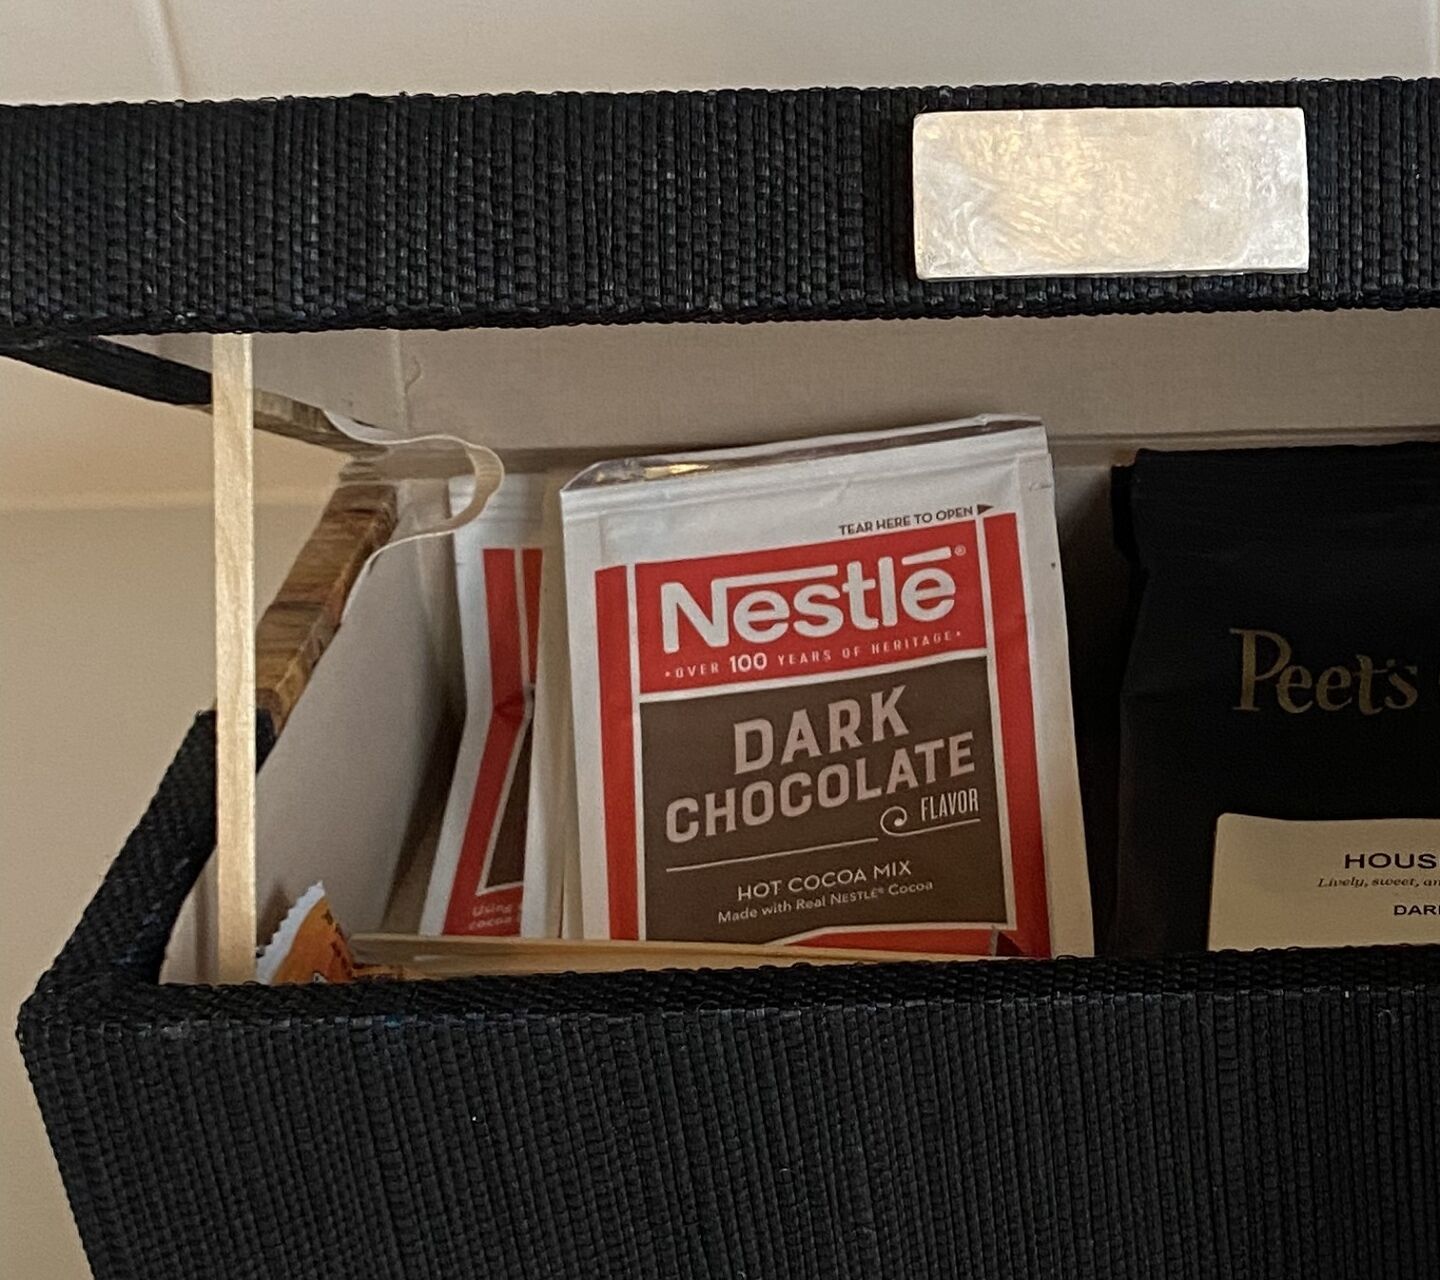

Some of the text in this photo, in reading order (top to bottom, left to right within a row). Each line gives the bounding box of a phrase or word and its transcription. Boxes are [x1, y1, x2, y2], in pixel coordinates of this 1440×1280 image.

[838, 505, 974, 536] TEAR HERE TO OPEN
[675, 632, 951, 680] OVER 100 YEARS OF HERITAGE
[734, 685, 909, 775] DARK
[665, 731, 975, 844] CHOCOLATE
[921, 788, 979, 822] FLAVOR
[717, 904, 757, 923] Made
[761, 900, 792, 915] with
[796, 895, 826, 911] Real
[888, 881, 934, 896] Cocoa
[737, 860, 912, 902] HOT COCOA MIX
[1318, 877, 1369, 889] Lively,
[1372, 878, 1420, 888] sweet,
